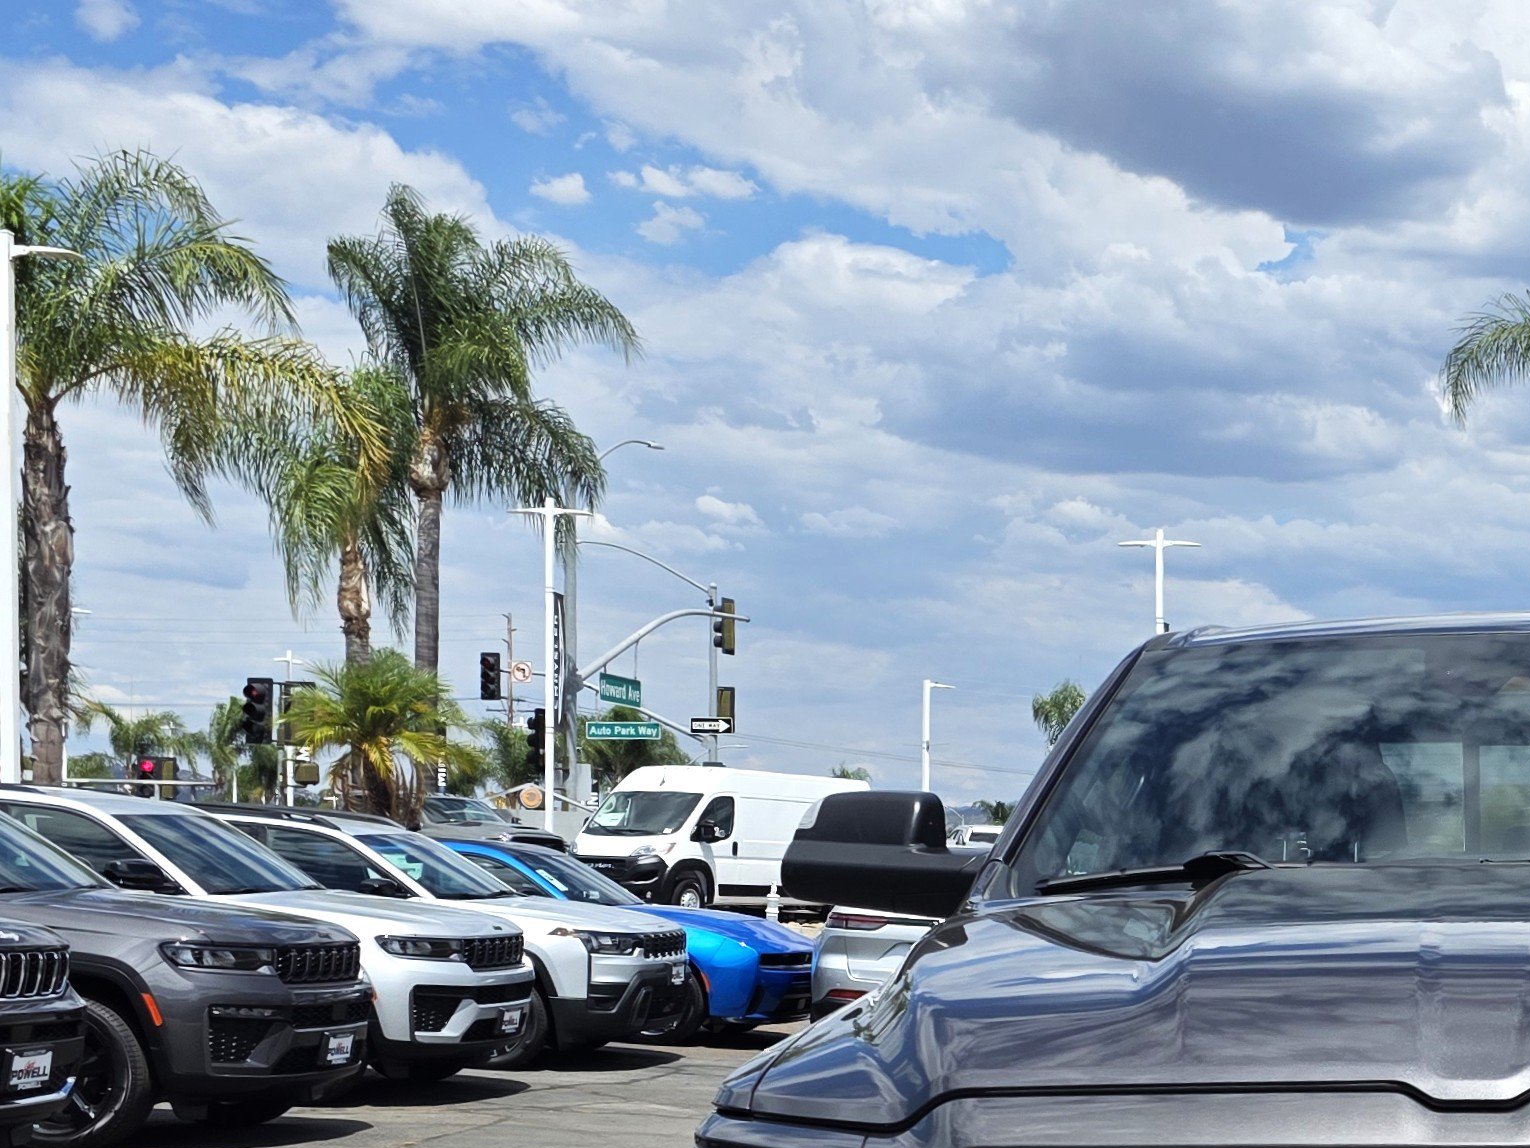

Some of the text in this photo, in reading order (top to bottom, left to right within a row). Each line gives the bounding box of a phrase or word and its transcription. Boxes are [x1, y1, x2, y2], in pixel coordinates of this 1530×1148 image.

[600, 679, 641, 703] Howard Ave
[589, 726, 657, 737] Auto Park Way
